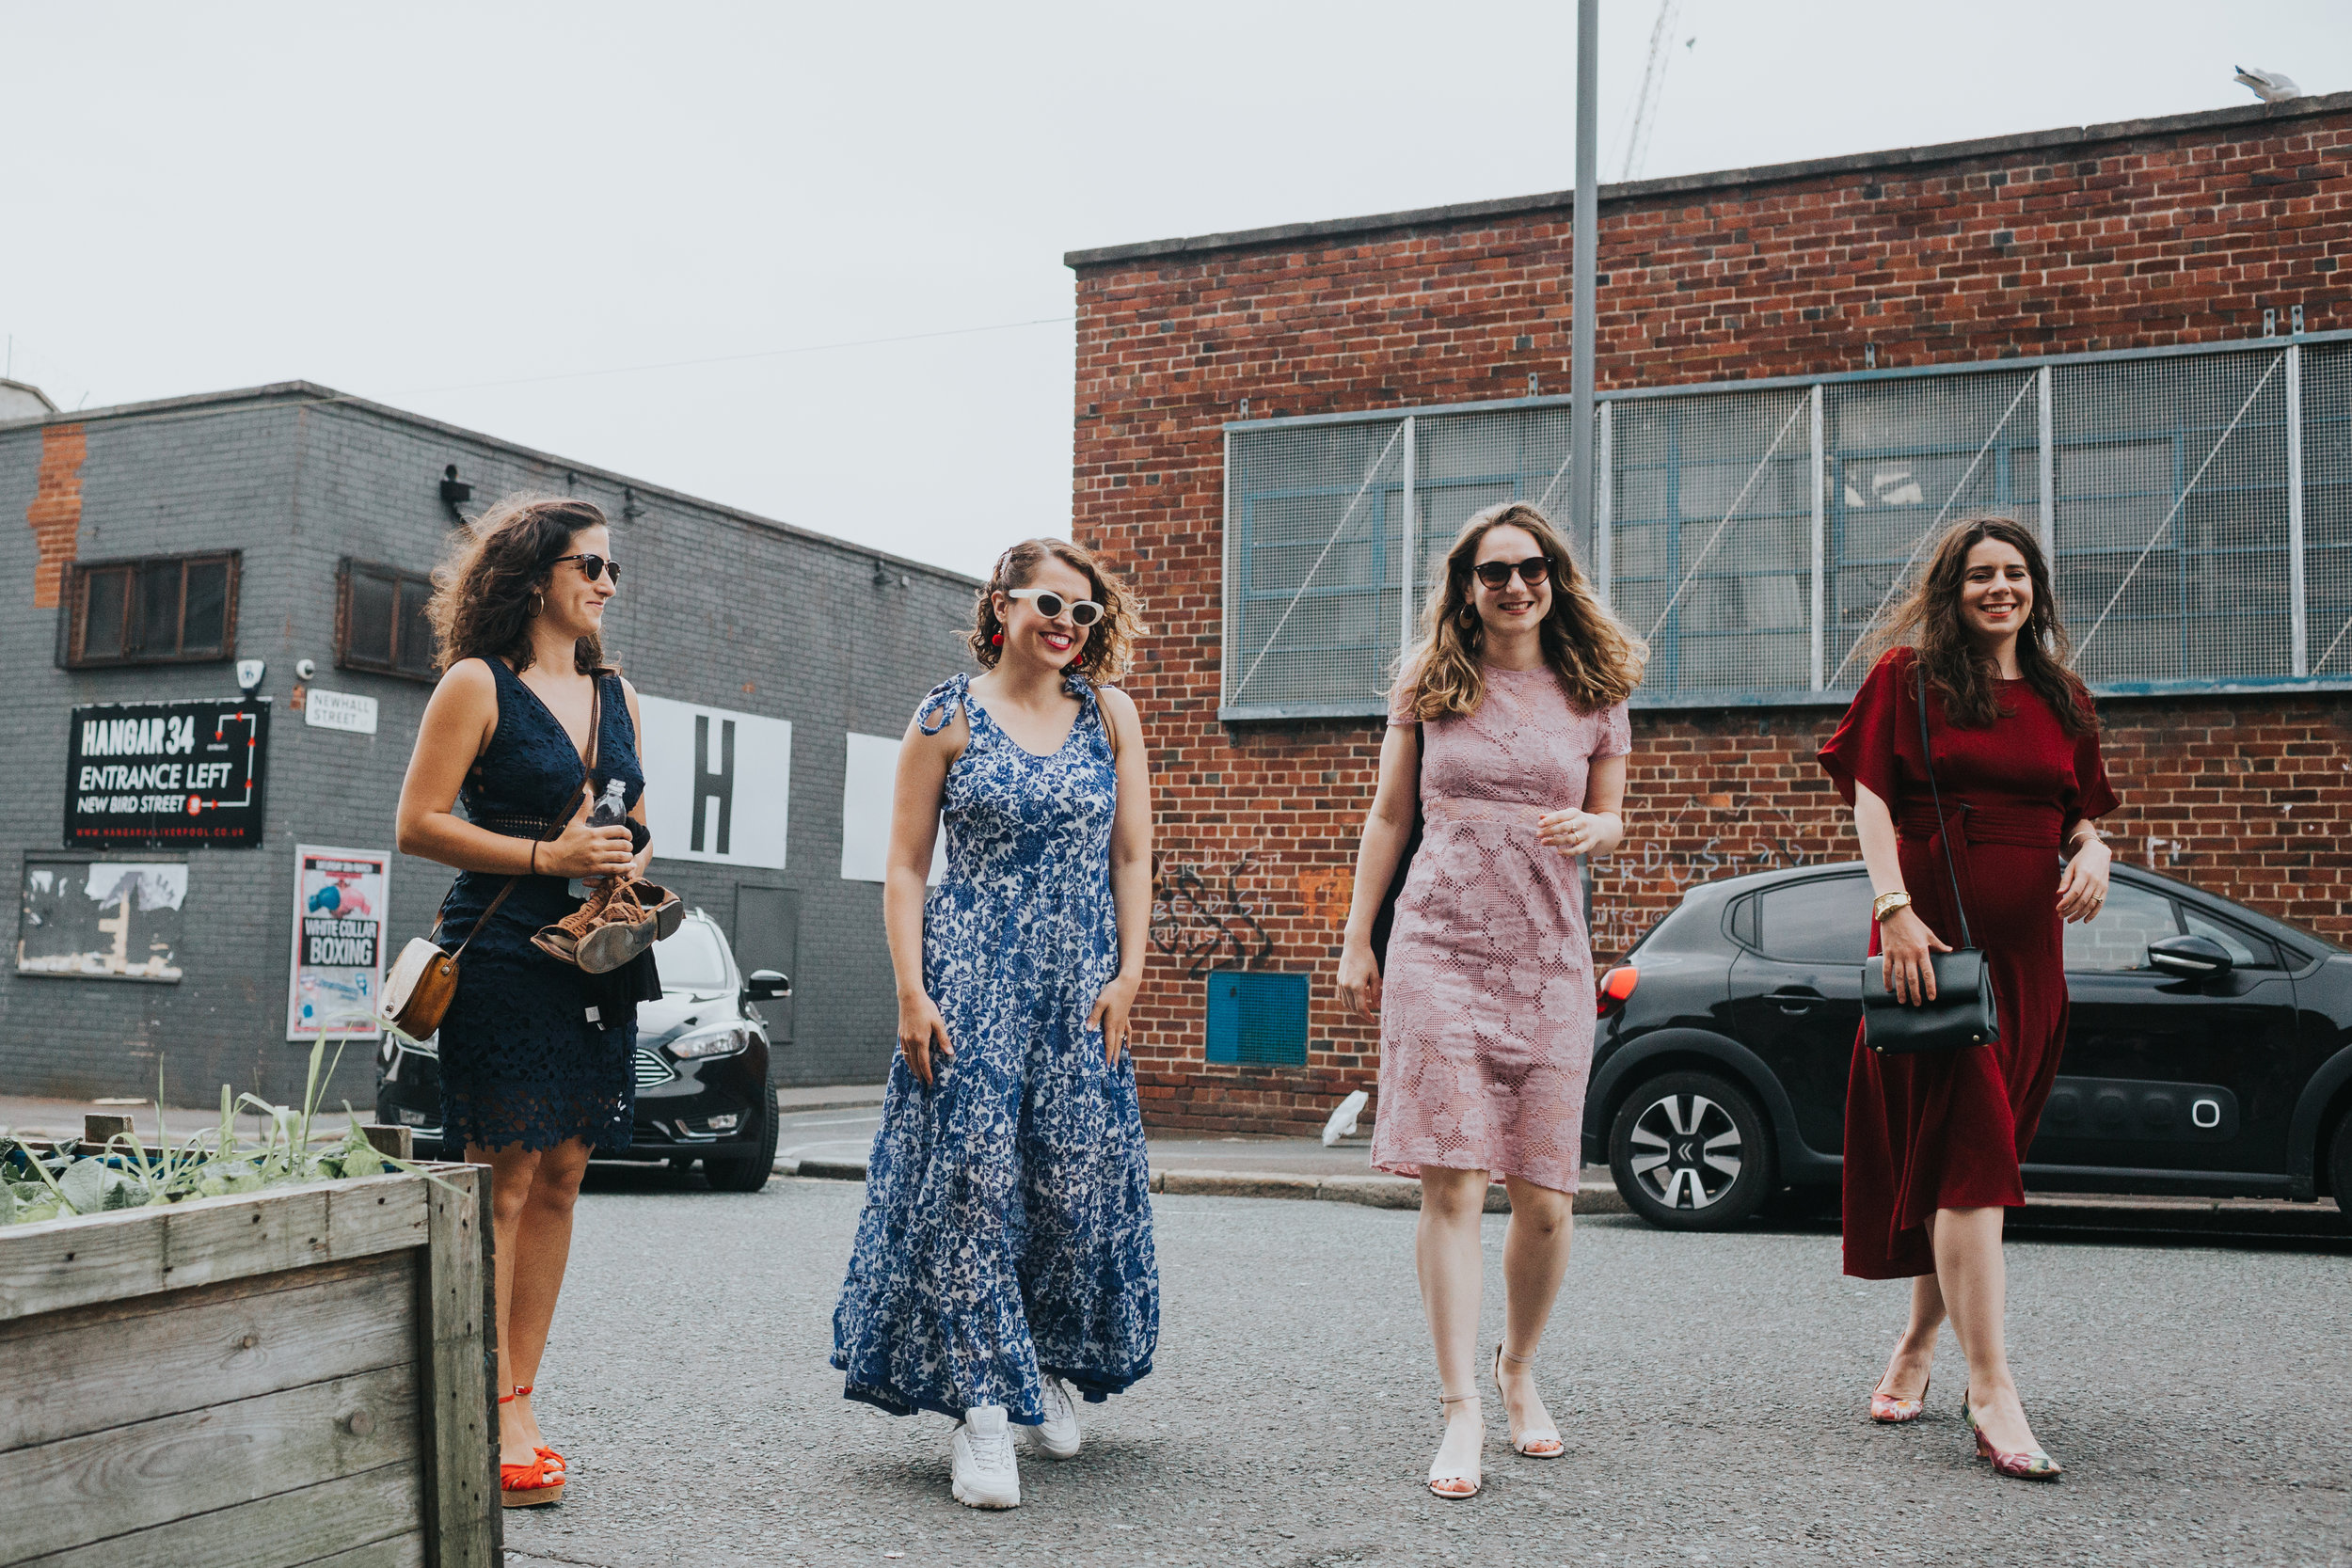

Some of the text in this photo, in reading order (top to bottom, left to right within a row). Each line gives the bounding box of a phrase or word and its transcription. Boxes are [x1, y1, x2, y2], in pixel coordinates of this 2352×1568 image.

[314, 694, 370, 713] NEWHALL
[314, 708, 357, 724] STREET
[81, 715, 196, 756] HANGAR 34
[79, 762, 232, 791] ENTRANCE LEFT
[691, 715, 736, 855] H
[76, 795, 186, 814] NEW BIRD STREET
[305, 919, 377, 939] WHITE COLLAR
[310, 937, 373, 965] BOXING
